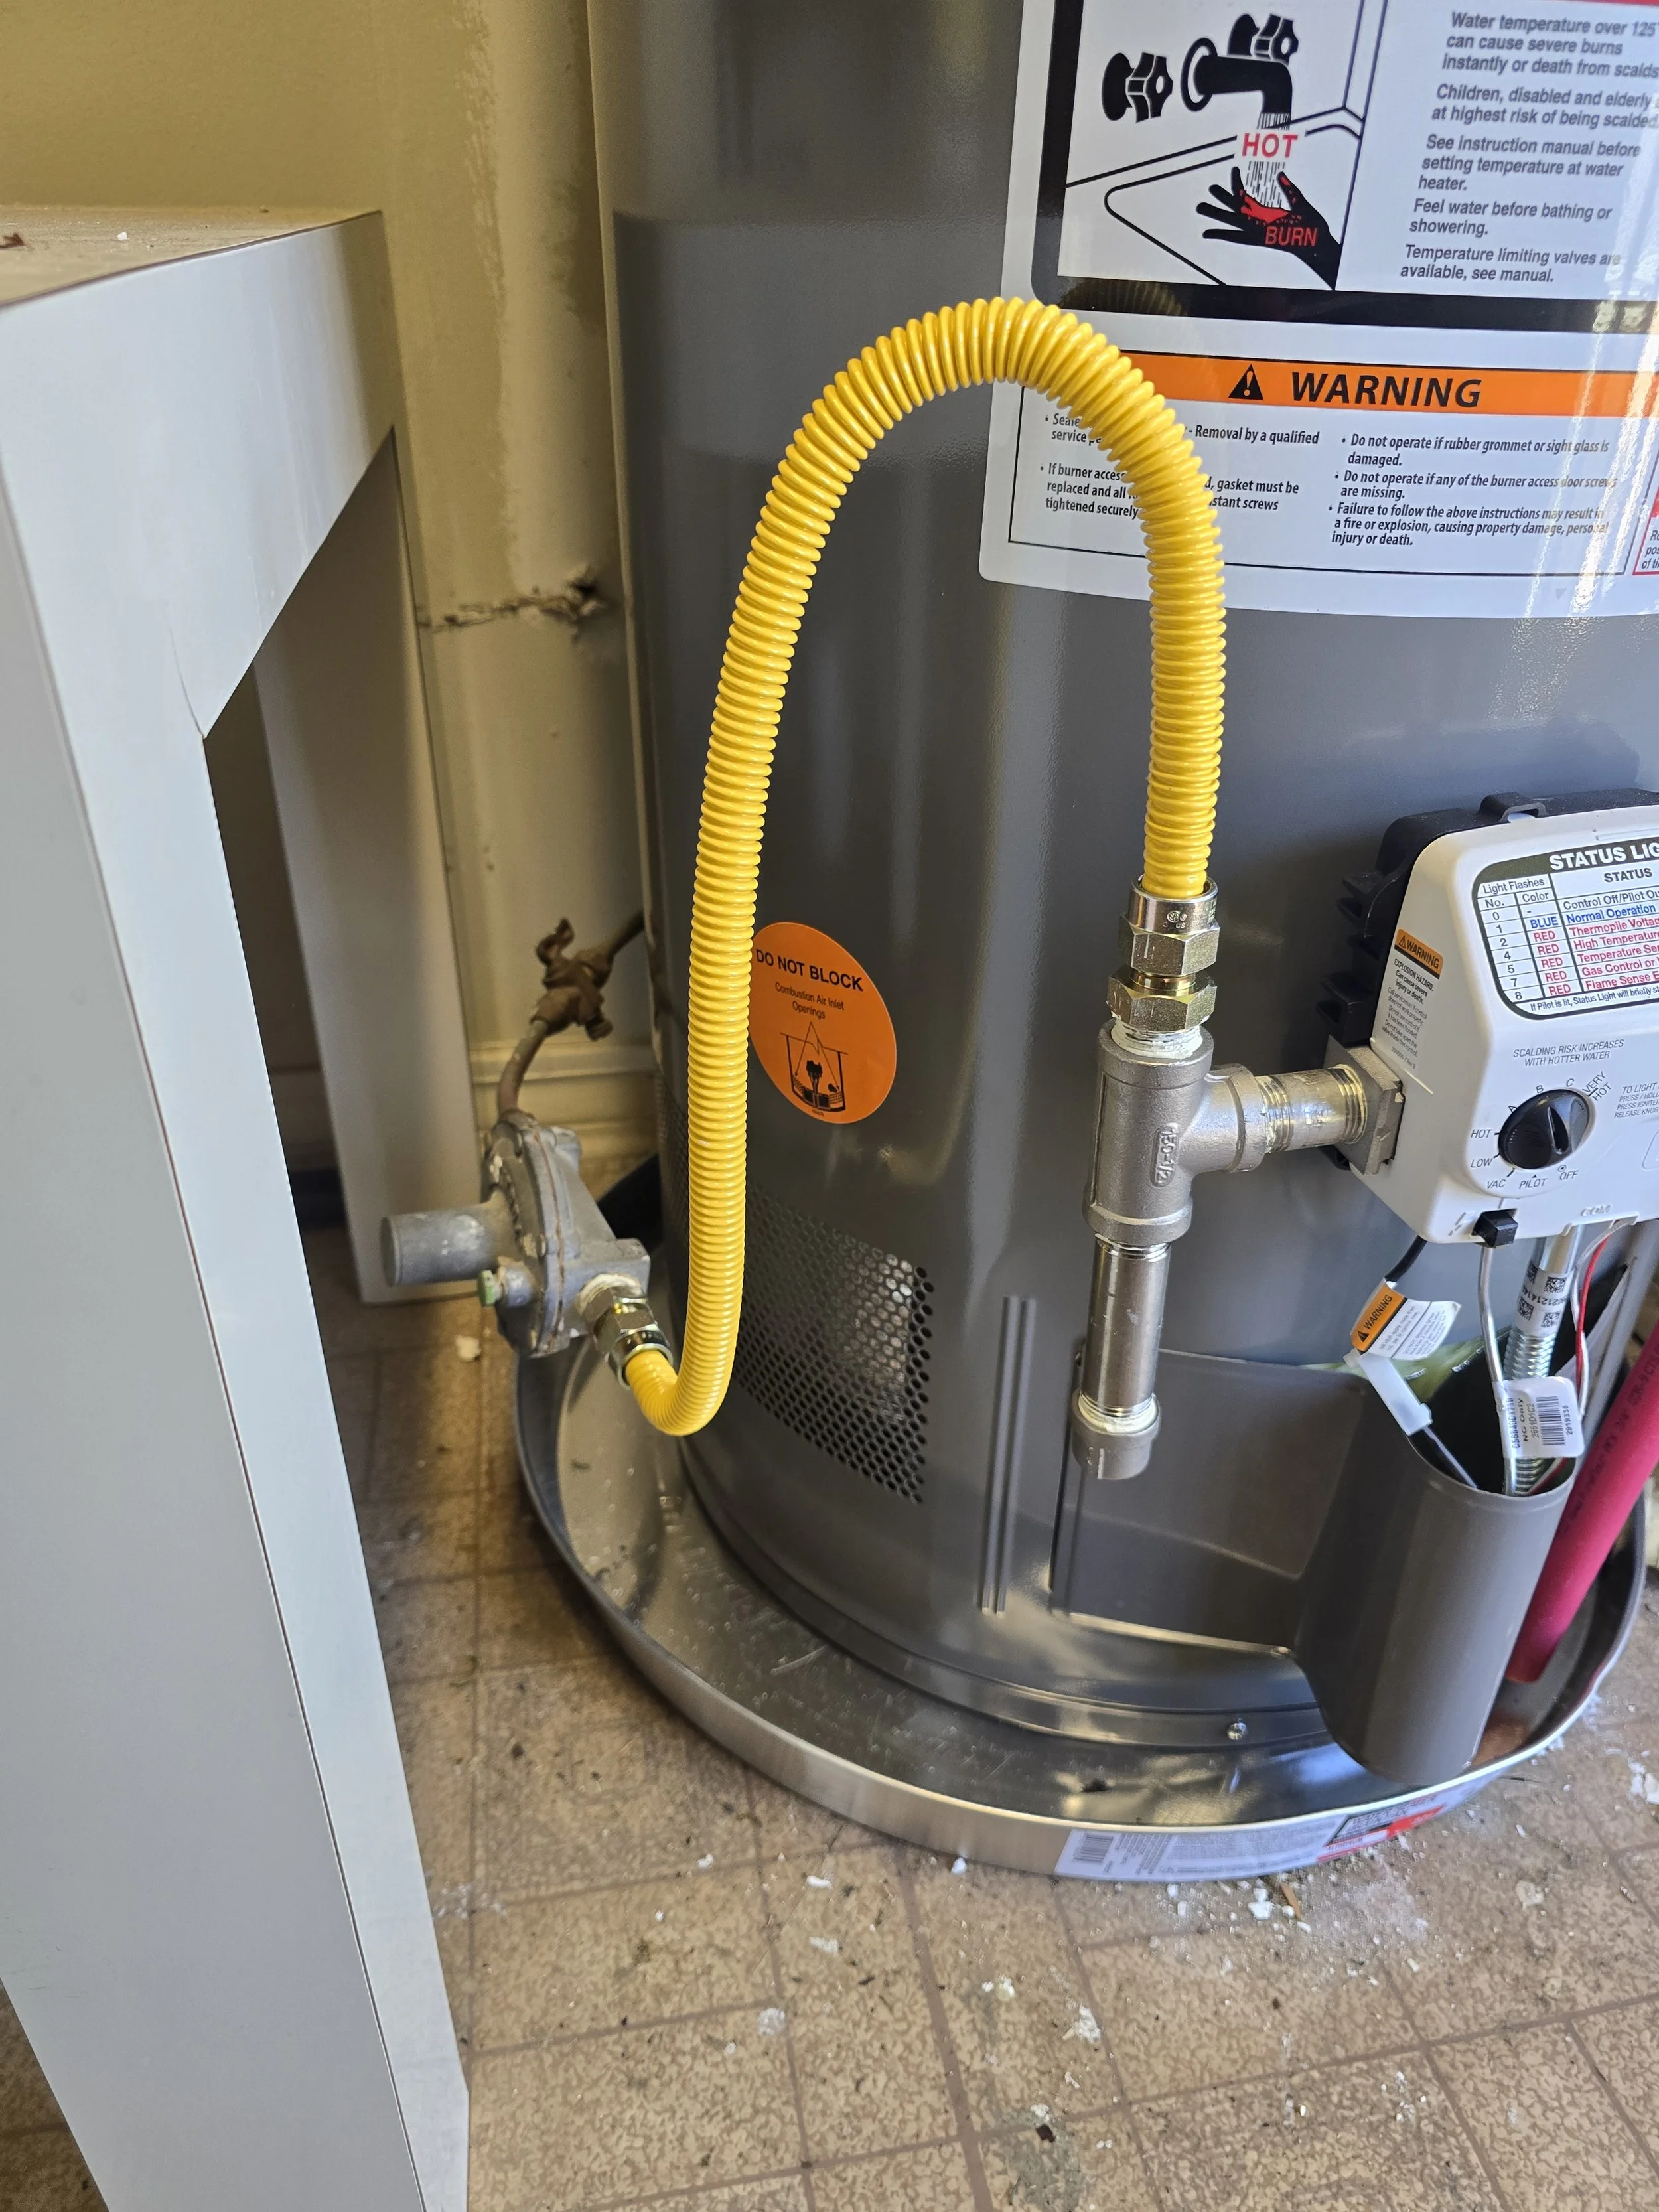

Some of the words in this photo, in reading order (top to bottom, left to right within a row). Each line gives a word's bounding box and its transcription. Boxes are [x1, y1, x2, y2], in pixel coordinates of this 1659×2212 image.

[1451, 11, 1495, 29] Water
[1500, 15, 1590, 34] temperature
[1595, 21, 1628, 35] over
[1447, 35, 1475, 49] can
[1479, 37, 1524, 50] cause
[1528, 39, 1577, 53] severe
[1581, 37, 1623, 55] burns
[1442, 53, 1508, 75] instantly
[1512, 58, 1528, 71] or
[1532, 57, 1572, 74] death
[1577, 59, 1610, 76] from
[1437, 84, 1504, 104] Children,
[1508, 87, 1571, 104] disabled
[1575, 90, 1601, 106] and
[1605, 92, 1652, 110] elderly
[1450, 106, 1506, 125] highest
[1510, 108, 1538, 123] risk
[1542, 110, 1557, 124] of
[1560, 110, 1599, 129] being
[1241, 133, 1299, 158] HOT
[1426, 134, 1454, 150] See
[1458, 135, 1537, 153] instruction
[1542, 139, 1593, 155] manual
[1597, 141, 1641, 157] before
[1422, 157, 1473, 175] setting
[1477, 158, 1564, 176] temperature
[1585, 163, 1623, 177] water
[1418, 175, 1467, 190] heater.
[1413, 198, 1444, 214] Feel
[1449, 200, 1489, 215] water
[1492, 201, 1537, 217] before
[1541, 202, 1593, 222] bathing
[1597, 206, 1613, 219] or
[1264, 226, 1318, 247] BURN
[1409, 218, 1489, 238] showering.
[1406, 244, 1494, 262] Temperature
[1498, 248, 1550, 265] limiting
[1554, 250, 1596, 265] valves
[1400, 265, 1467, 281] available,
[1500, 269, 1555, 283] manual.
[1291, 371, 1482, 408] WARNING
[1051, 430, 1086, 442] service
[1195, 425, 1243, 440] Removal
[1269, 430, 1320, 445] qualified
[1351, 433, 1365, 446] Do
[1368, 436, 1387, 447] not
[1390, 437, 1432, 451] operate
[1444, 437, 1481, 450] rubber
[1482, 439, 1532, 453] grommet
[1546, 439, 1573, 455] sight
[1348, 451, 1402, 468] damaged.
[1058, 463, 1092, 478] burner
[1344, 470, 1358, 482] Do
[1361, 472, 1380, 483] not
[1382, 473, 1424, 487] operate
[1436, 476, 1456, 488] any
[1457, 473, 1471, 486] of
[1471, 473, 1489, 486] the
[1490, 474, 1527, 487] burner
[1047, 481, 1090, 495] replaced
[1092, 485, 1111, 497] and
[1217, 479, 1254, 492] gasket
[1256, 482, 1283, 493] must
[1361, 486, 1406, 501] missing.
[1045, 497, 1095, 513] tightened
[1096, 505, 1139, 520] securely
[1242, 498, 1279, 510] screws
[1337, 502, 1374, 515] Failure
[1390, 504, 1425, 517] follow
[1427, 505, 1444, 518] the
[1446, 506, 1478, 519] above
[1479, 506, 1540, 519] instructions
[1344, 517, 1361, 530] fire
[1378, 519, 1431, 534] explosion,
[1434, 521, 1475, 536] causing
[1475, 523, 1521, 536] property
[1522, 522, 1565, 537] damage,
[1331, 531, 1364, 546] injury
[1379, 533, 1413, 546] death.
[1549, 846, 1627, 871] STATUS
[1604, 868, 1652, 883] STATUS
[1482, 883, 1508, 895] Light
[1508, 878, 1545, 891] Flashes
[1485, 899, 1505, 908] No.
[1522, 892, 1549, 903] Color
[1492, 912, 1500, 921] 0
[1563, 897, 1602, 910] Control
[1603, 889, 1644, 905] Off/Pilot
[1496, 924, 1502, 933] 1
[1529, 916, 1559, 929] BLUE
[1566, 909, 1605, 924] Normal
[1606, 904, 1656, 919] Operation
[1500, 938, 1508, 946] 2
[1533, 930, 1555, 942] RED
[1569, 920, 1627, 937] Thermopile
[1407, 939, 1440, 969] WARNING
[1504, 950, 1512, 960] 4
[1537, 944, 1559, 956] RED
[1573, 940, 1598, 950] High
[1507, 964, 1515, 973] 5
[1541, 957, 1563, 969] RED
[1577, 944, 1642, 964] Temperature
[756, 948, 774, 966] DO
[778, 956, 805, 976] NOT
[809, 966, 864, 992] BLOCK
[1394, 958, 1416, 978] EXPLOSION
[1416, 973, 1433, 991] HAZARD.
[1510, 978, 1518, 988] 7
[1545, 970, 1567, 982] RED
[1582, 966, 1603, 977] Gas
[1605, 960, 1643, 973] Control
[774, 982, 815, 1003] Combustion
[816, 995, 826, 1007] Air
[828, 997, 845, 1011] Inlet
[1514, 992, 1522, 1000] 8
[1548, 984, 1571, 995] RED
[1585, 978, 1618, 990] Flame
[1619, 973, 1651, 985] Sense
[1537, 999, 1554, 1010] Pilot
[1573, 995, 1597, 1005] Status
[1598, 990, 1617, 1002] Light
[792, 1002, 826, 1020] Openings
[1513, 1046, 1556, 1058] SCALDING
[1559, 1045, 1578, 1054] RISK
[1578, 1039, 1624, 1052] INCREASES
[1524, 1057, 1546, 1067] WITH
[1548, 1054, 1581, 1065] HOTTER
[1582, 1051, 1610, 1061] WATER
[1536, 1085, 1544, 1094] B
[1566, 1078, 1575, 1087] C
[1582, 1071, 1606, 1093] VERY
[1634, 1082, 1658, 1092] LIGHT
[1593, 1084, 1612, 1102] HOT
[1614, 1110, 1642, 1118] RELEASE
[1470, 1129, 1492, 1139] HOT
[1471, 1158, 1493, 1168] LOW
[1486, 1179, 1506, 1189] VAC
[1518, 1178, 1548, 1189] PILOT
[1559, 1170, 1579, 1180] OFF
[1363, 1294, 1393, 1330] WARNING
[1520, 1426, 1529, 1443] NG
